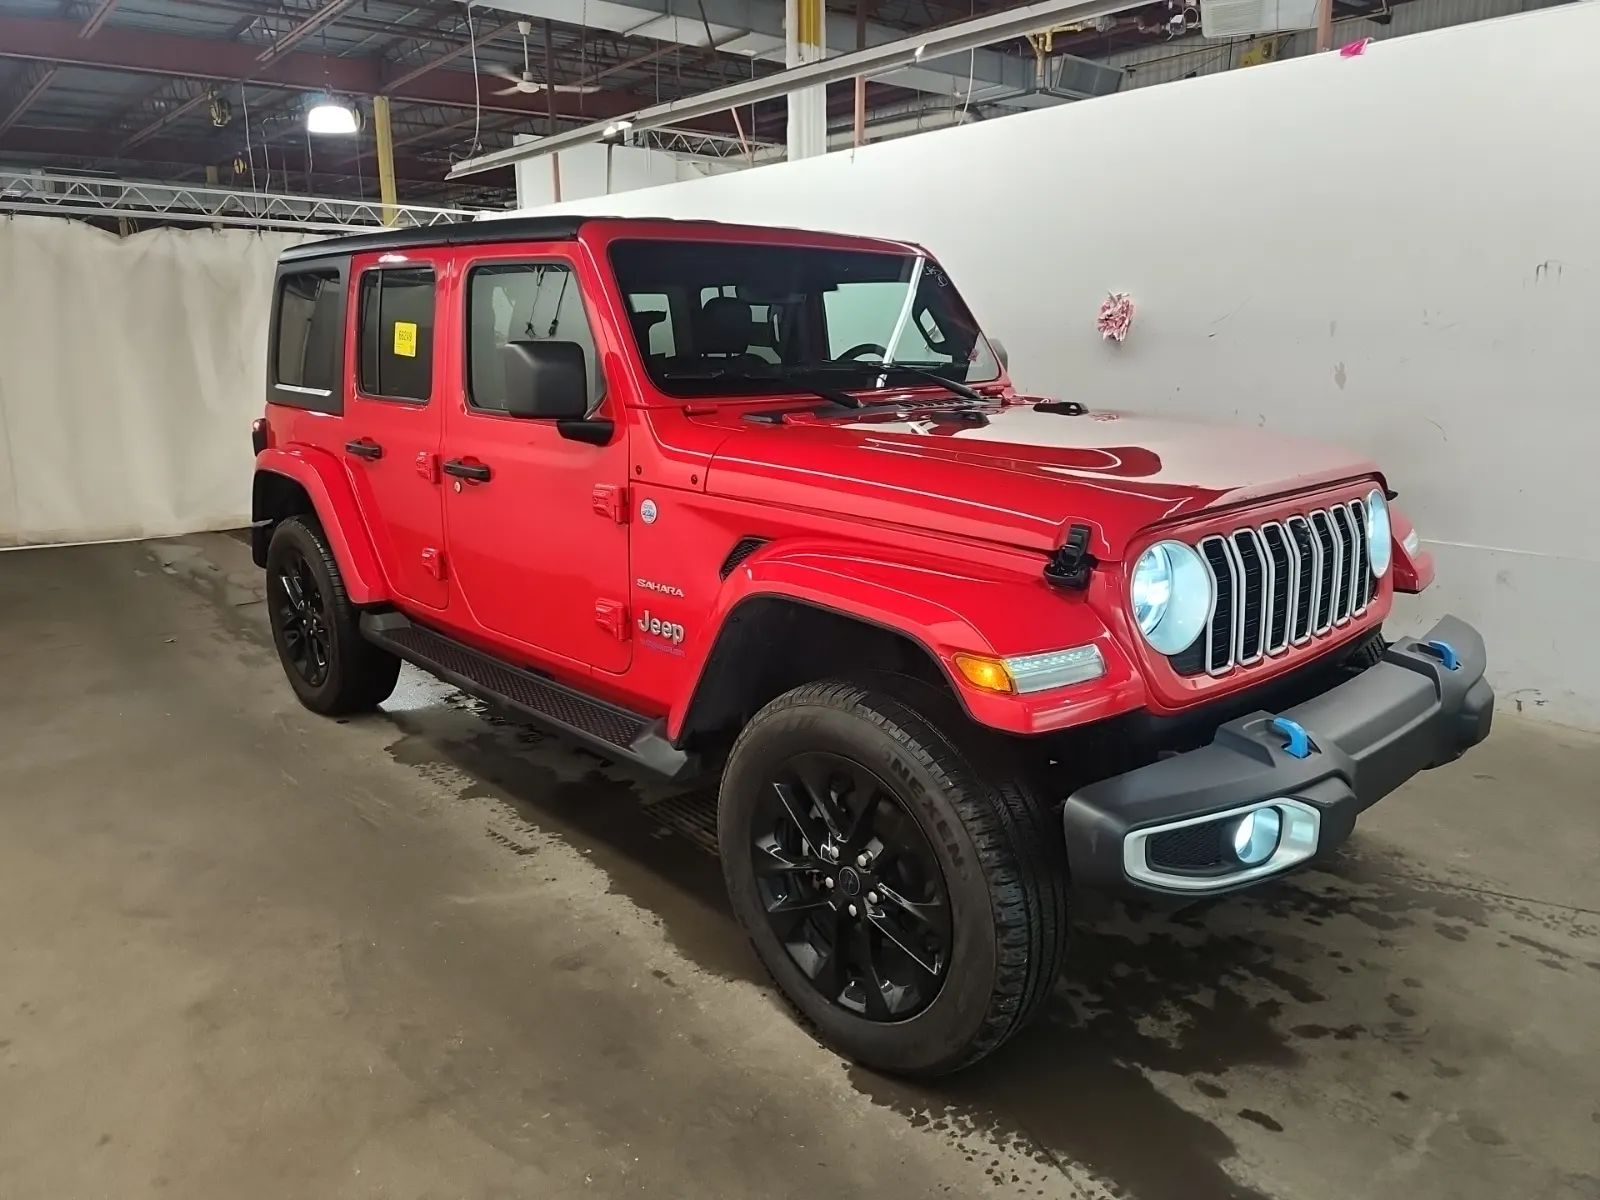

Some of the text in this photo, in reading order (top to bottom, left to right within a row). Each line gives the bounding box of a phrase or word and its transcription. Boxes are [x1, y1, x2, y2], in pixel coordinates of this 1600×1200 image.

[636, 578, 685, 598] SAHARA
[637, 609, 685, 645] Jeep
[890, 757, 965, 868] NEXEN
